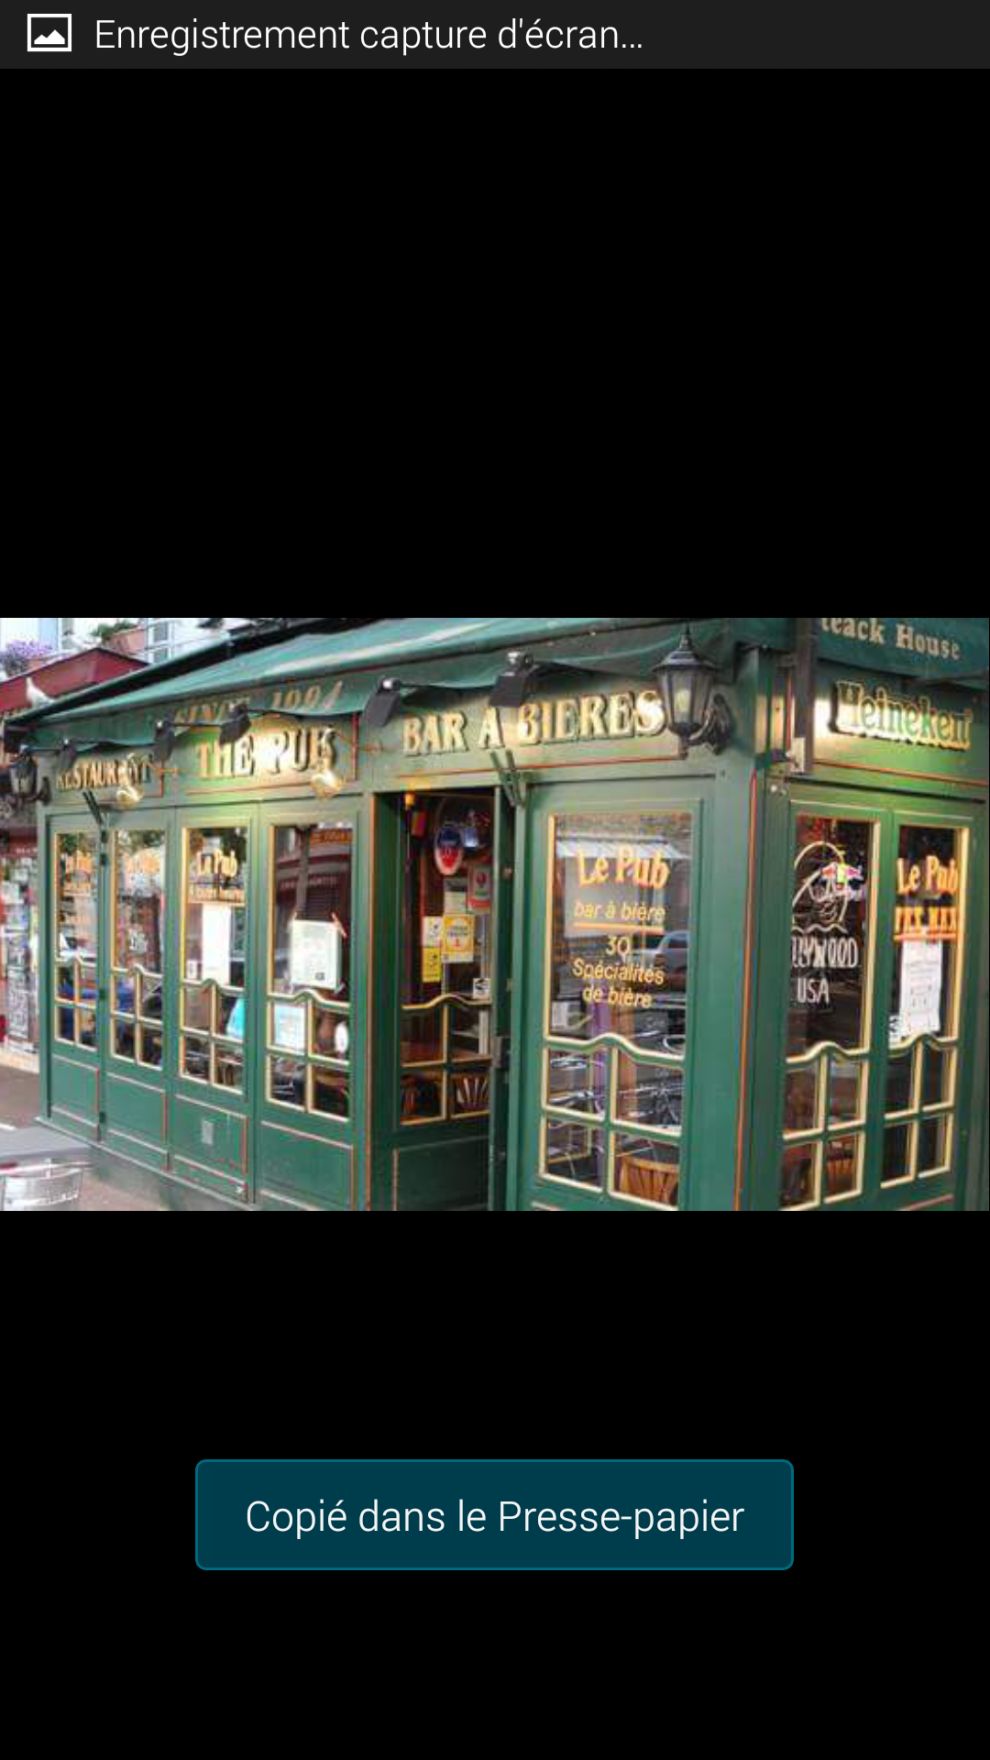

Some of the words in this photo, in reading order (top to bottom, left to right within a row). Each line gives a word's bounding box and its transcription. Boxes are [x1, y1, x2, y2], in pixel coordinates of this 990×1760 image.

[895, 623, 960, 660] House
[403, 711, 467, 755] BAR
[833, 679, 973, 752] Heineken
[198, 732, 255, 779] THE
[576, 848, 609, 888] Le
[614, 843, 671, 890] Pub
[896, 857, 921, 896] Le
[925, 855, 959, 895] Pub
[573, 902, 600, 919] bar
[620, 903, 667, 925] bière
[582, 983, 603, 1002] de
[608, 985, 653, 1009] bière
[797, 977, 830, 1006] USA
